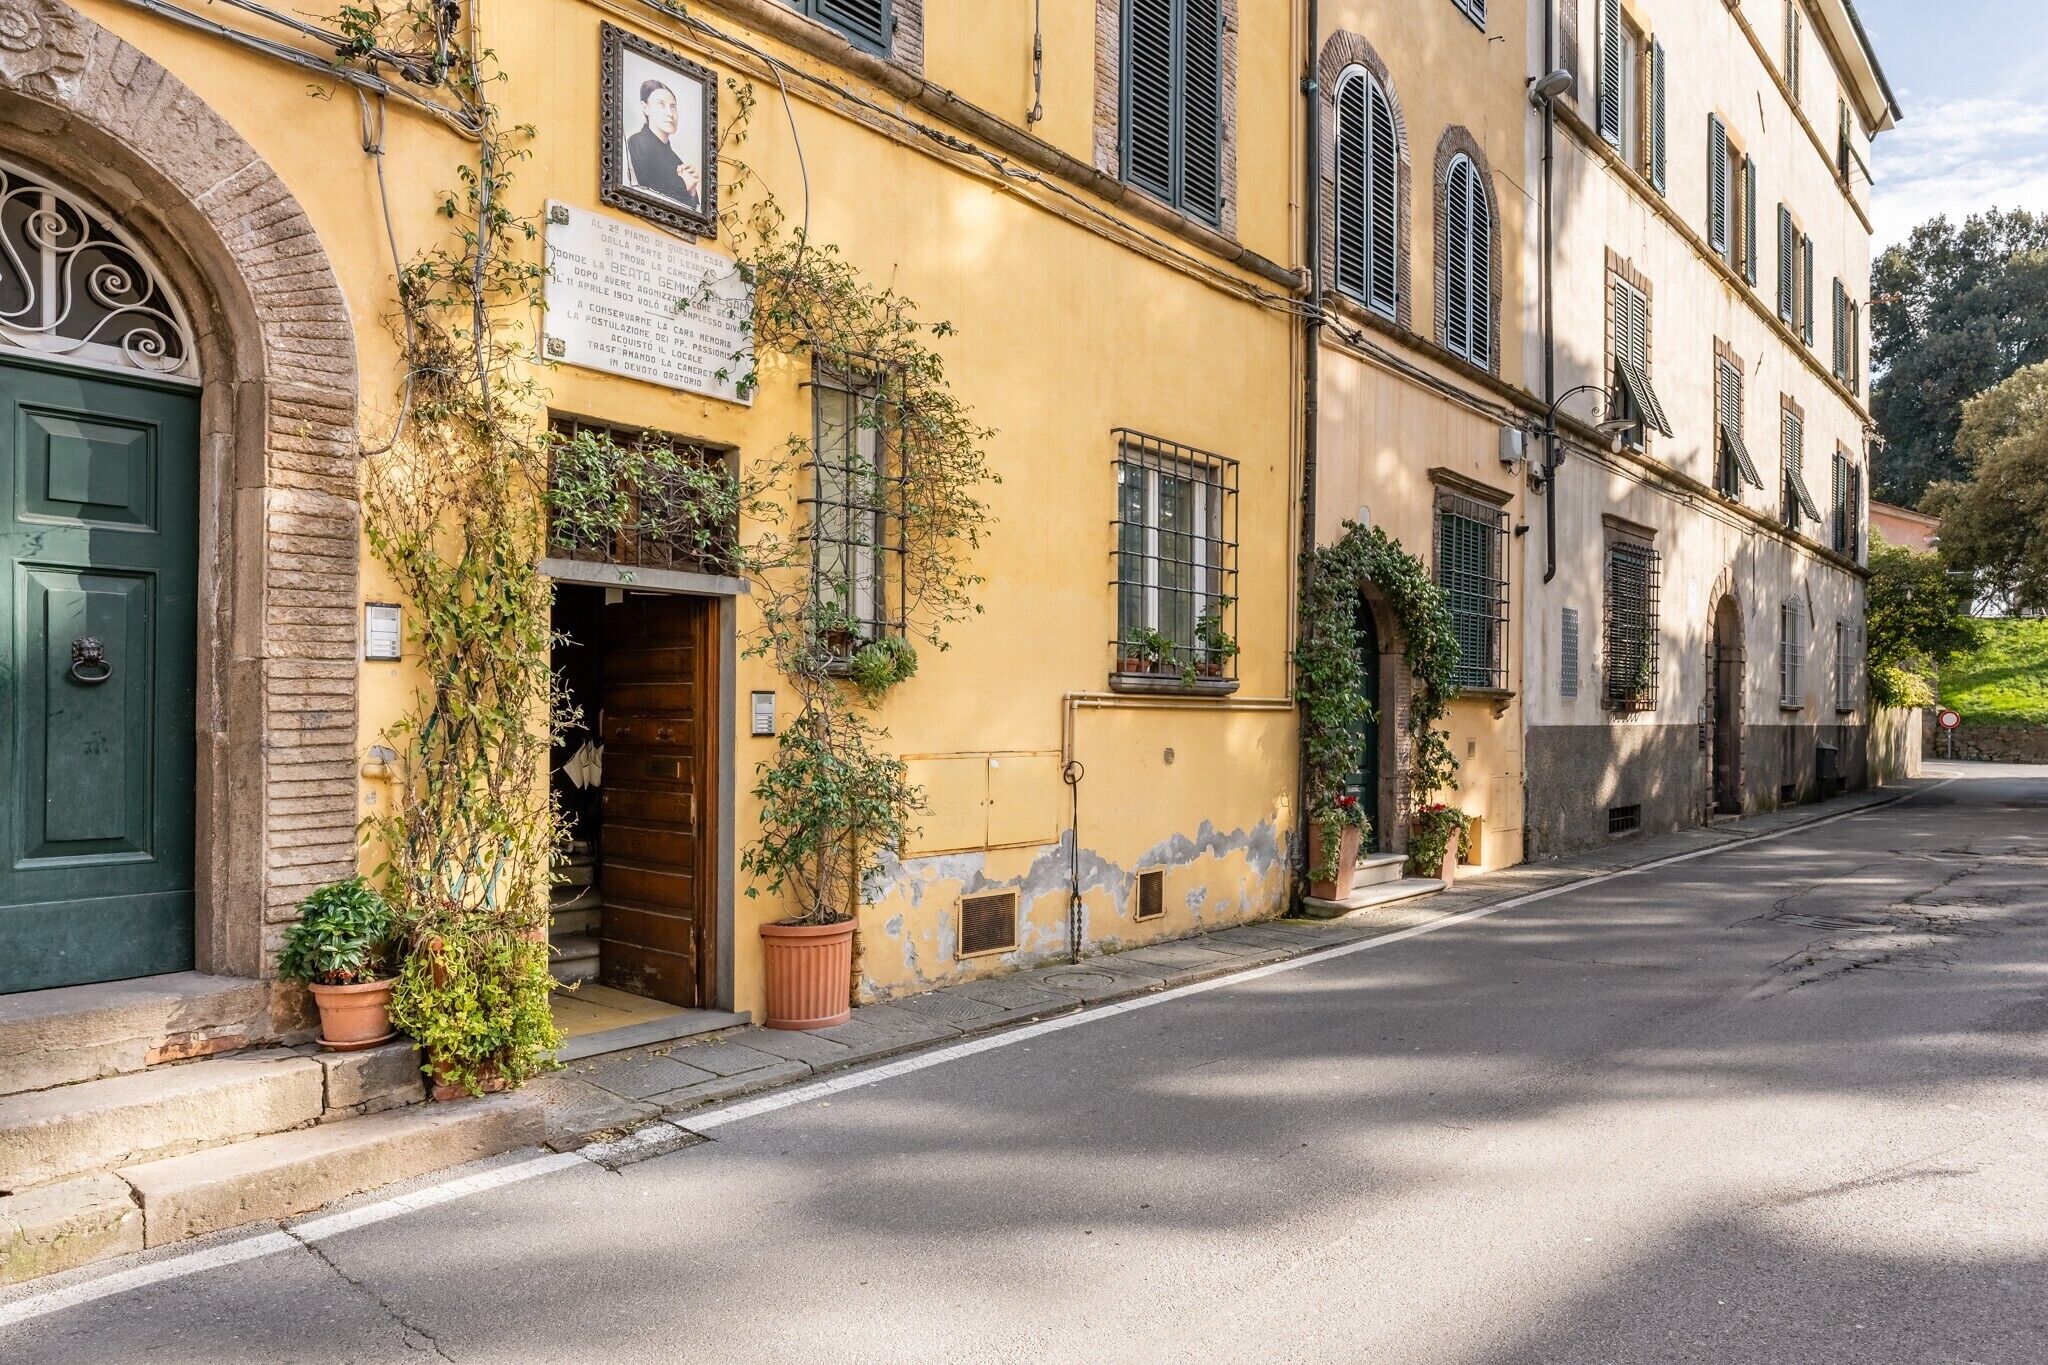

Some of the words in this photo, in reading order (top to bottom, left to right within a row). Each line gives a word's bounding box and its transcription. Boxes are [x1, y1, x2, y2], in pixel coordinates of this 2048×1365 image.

[592, 219, 602, 228] AL
[625, 229, 649, 243] PIANO
[669, 244, 698, 259] QUESTA
[704, 256, 723, 268] CASA
[602, 234, 629, 249] DALLA
[636, 245, 662, 259] PARTE
[668, 255, 675, 263] DI
[557, 250, 586, 265] DONDE
[594, 260, 604, 270] LA
[611, 262, 650, 283] BEATA
[659, 276, 697, 296] GEMMA
[605, 248, 613, 256] SI
[619, 252, 645, 266] TROVA
[652, 262, 661, 271] LA
[575, 267, 598, 280] DOPO
[605, 276, 631, 289] AVERE
[692, 301, 711, 313] COME
[579, 281, 609, 296] APRILE
[614, 290, 633, 302] 1903
[568, 310, 578, 320] LA
[586, 316, 650, 338] POSTULAZIONE
[656, 333, 668, 343] DEI
[675, 339, 687, 348] PP.
[590, 303, 651, 326] CONSERVARNE
[658, 322, 668, 330] LA
[674, 326, 694, 338] CARA
[700, 334, 731, 348] MEMORIA
[587, 340, 656, 363] TRASFORMANDO
[662, 359, 671, 367] LA
[659, 346, 666, 354] IL
[672, 350, 702, 364] LOCALE
[624, 362, 657, 376] DEVOTO
[664, 372, 701, 386] ORATORIO
